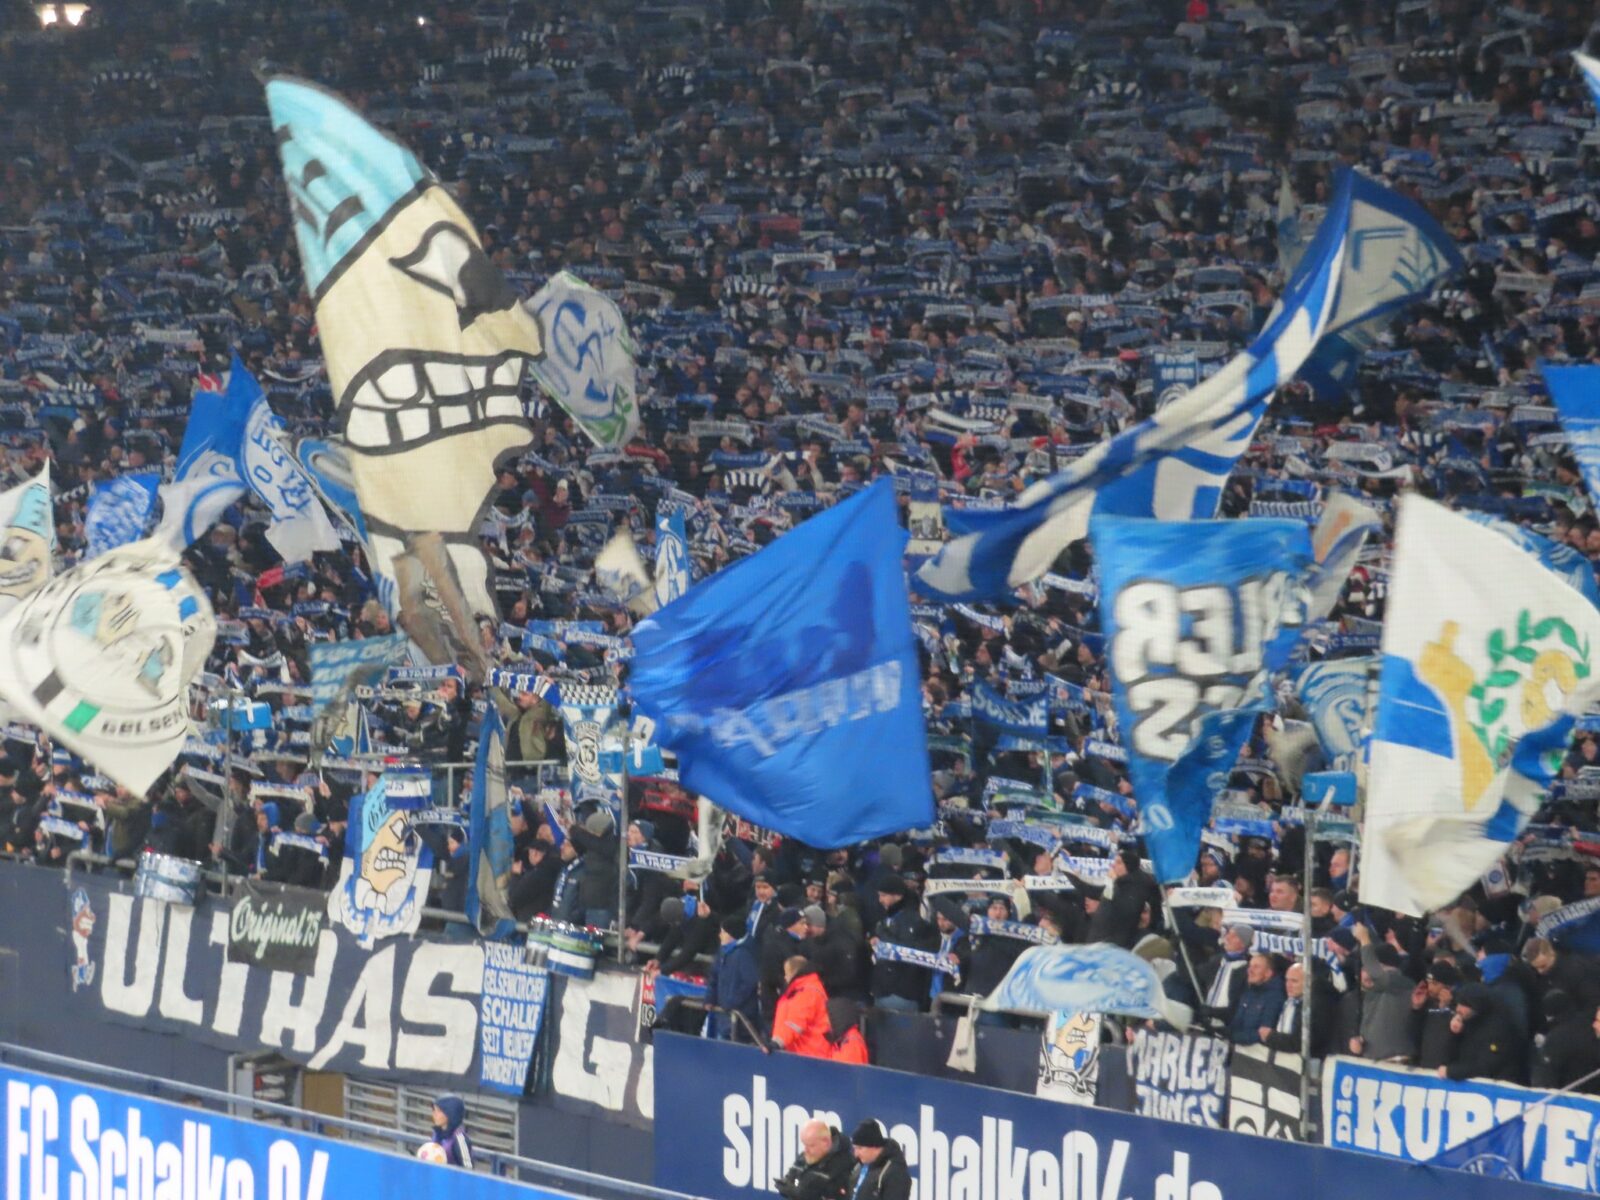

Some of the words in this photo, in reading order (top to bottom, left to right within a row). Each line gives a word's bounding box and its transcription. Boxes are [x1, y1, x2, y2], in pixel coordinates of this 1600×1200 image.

[231, 896, 306, 959] Original
[100, 892, 485, 1075] ULTRAS
[1126, 1028, 1230, 1096] MARLER
[1354, 1077, 1593, 1190] KURVE
